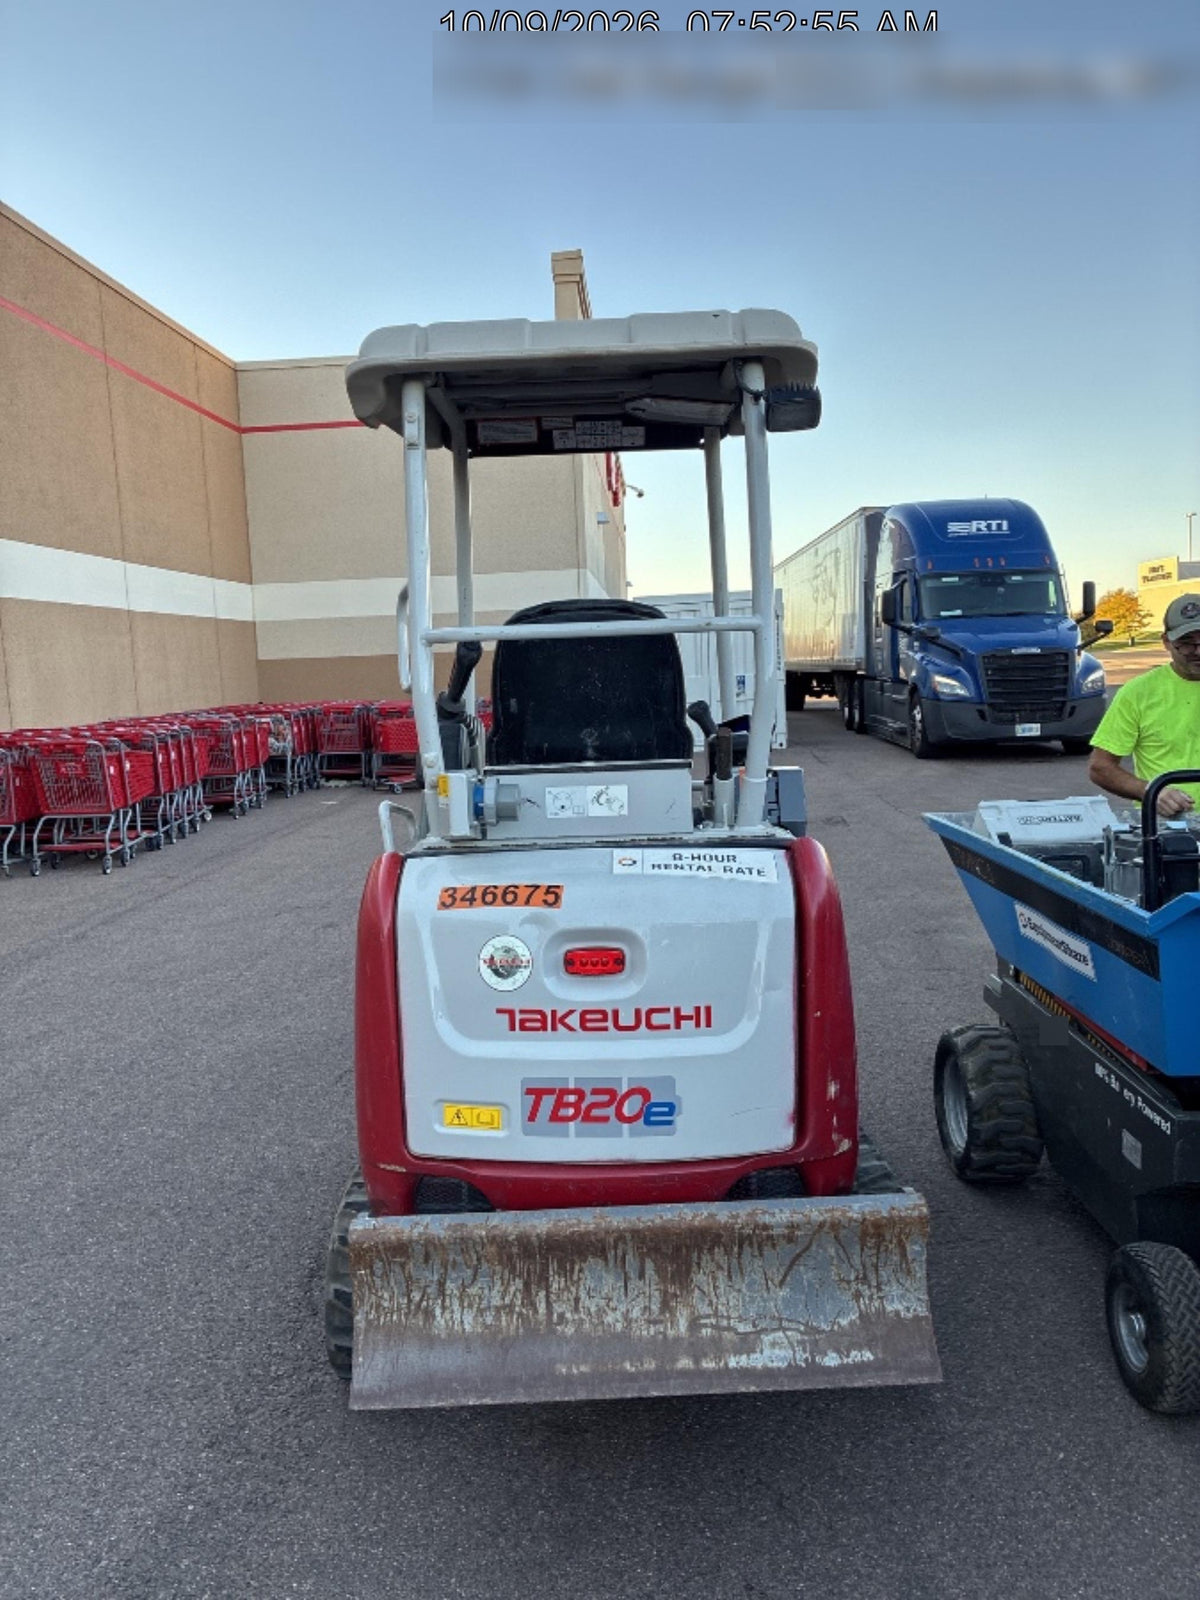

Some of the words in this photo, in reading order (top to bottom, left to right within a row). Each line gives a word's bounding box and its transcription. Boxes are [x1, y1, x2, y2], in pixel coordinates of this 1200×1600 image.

[970, 519, 1009, 533] RTI
[651, 863, 714, 873] RENTAL
[723, 865, 767, 877] RATE
[440, 884, 562, 909] 346675
[524, 1086, 677, 1127] TB20e
